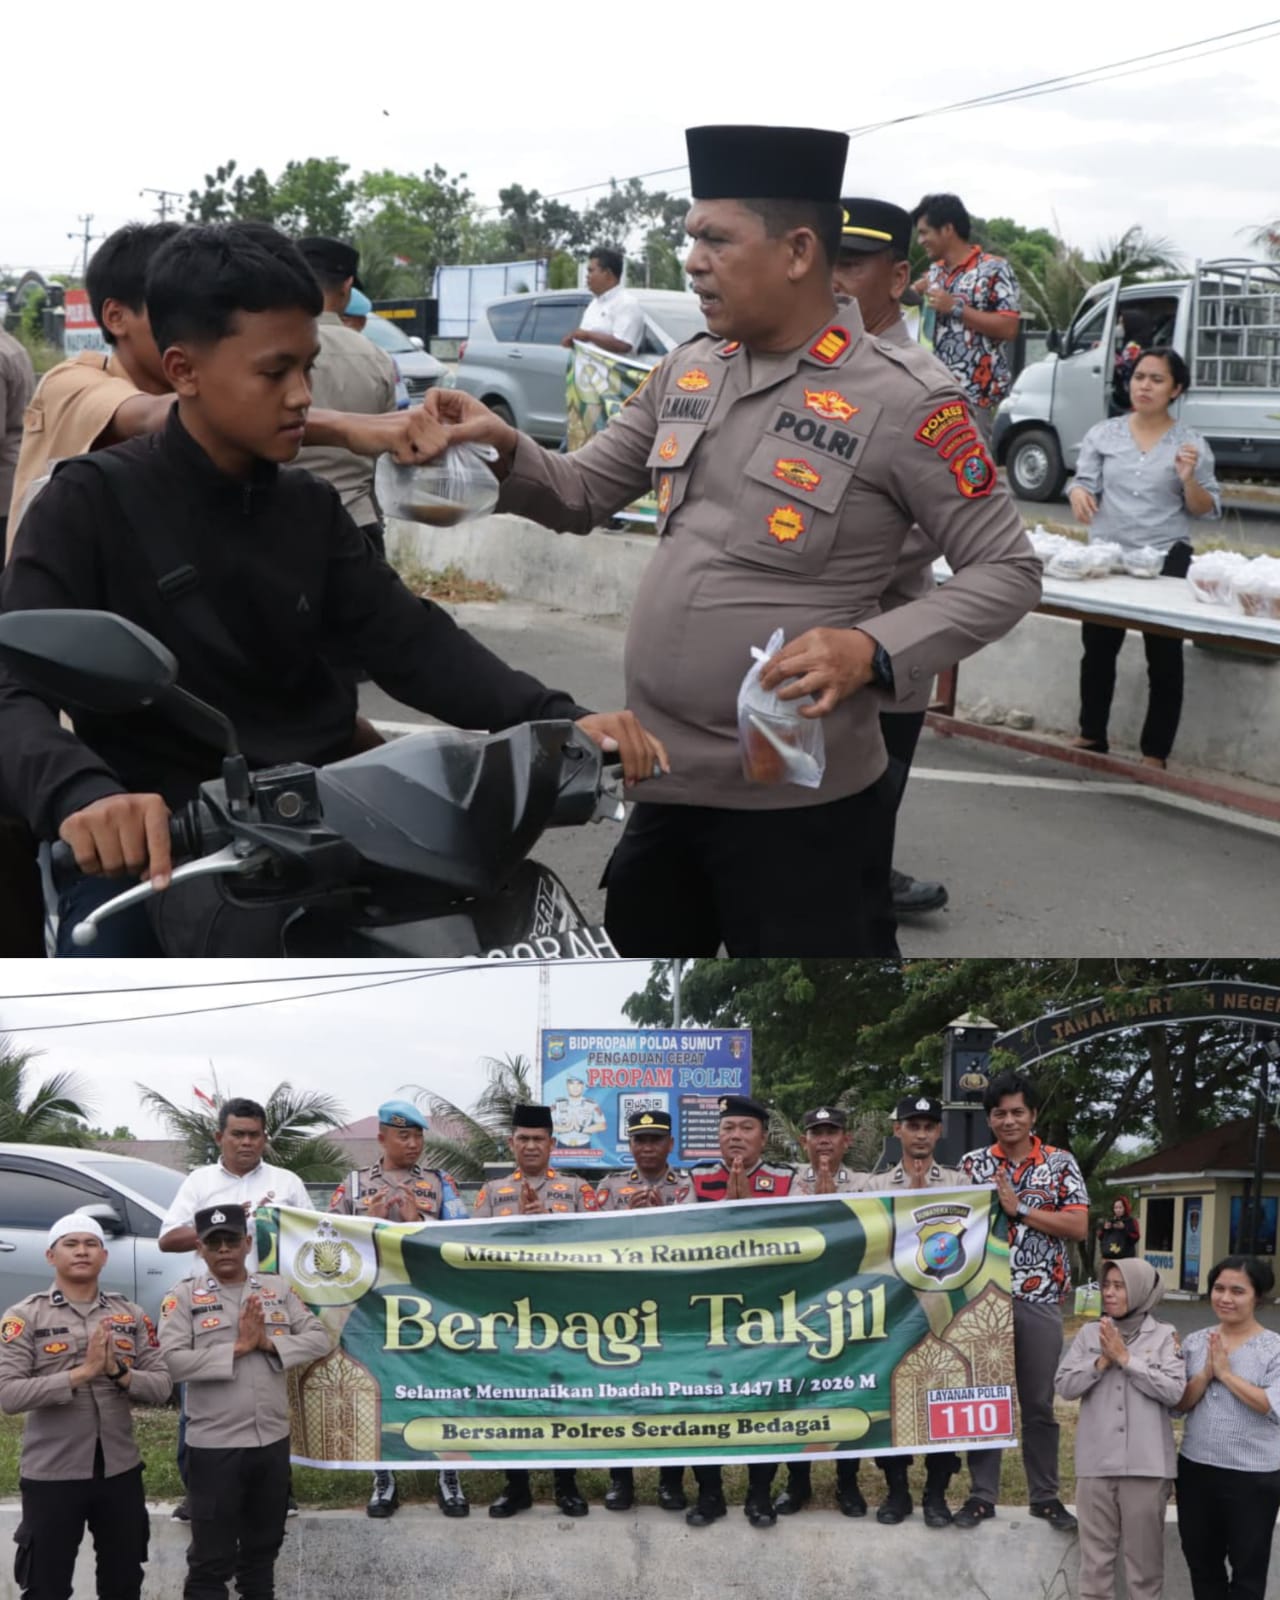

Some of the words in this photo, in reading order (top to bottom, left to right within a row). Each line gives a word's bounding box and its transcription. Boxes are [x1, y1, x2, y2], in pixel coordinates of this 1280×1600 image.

[921, 405, 963, 438] POLRES
[773, 411, 858, 460] POLRI
[1051, 1006, 1116, 1040] TANAH
[569, 1036, 636, 1050] BIDPROPAM
[640, 1036, 678, 1050] POLDA
[681, 1036, 722, 1050] SUMUT
[587, 1052, 663, 1065] PENGADUAN
[666, 1052, 705, 1065] CEPAT
[587, 1068, 673, 1088] PROPAM
[679, 1067, 742, 1088] POLRI
[463, 1244, 603, 1265] Marhaban
[611, 1247, 643, 1265] Ya
[651, 1237, 801, 1263] Ramadhan
[382, 1294, 663, 1367] Berbagi
[690, 1283, 889, 1361] Takjil
[395, 1384, 472, 1400] Selamat
[476, 1383, 593, 1400] Menunaikan
[598, 1381, 664, 1399] Ibadah
[668, 1380, 724, 1397] Puasa
[729, 1380, 772, 1396] 1447
[777, 1378, 792, 1394] H
[797, 1377, 806, 1396] /
[809, 1375, 855, 1391] 2026
[859, 1374, 877, 1389] M
[929, 1388, 974, 1402] LAYANAN
[976, 1386, 1008, 1400] POLRI
[442, 1422, 544, 1440] Bersama
[551, 1421, 625, 1439] Polres
[631, 1419, 731, 1441] Serdang
[736, 1415, 831, 1439] Bedagai
[941, 1402, 998, 1435] 110
